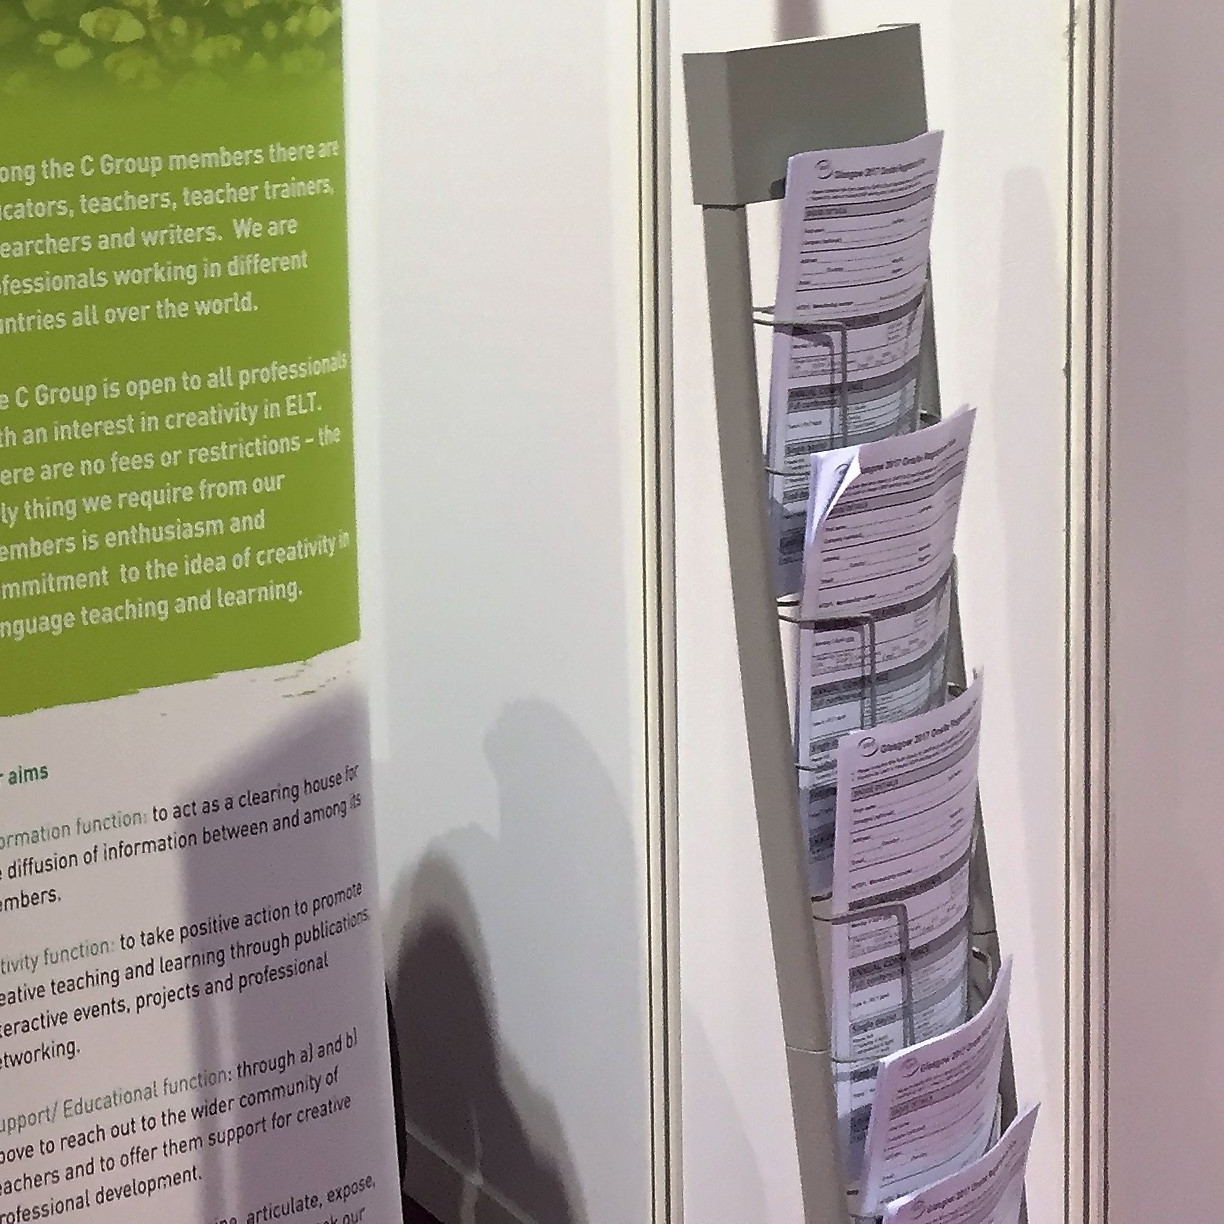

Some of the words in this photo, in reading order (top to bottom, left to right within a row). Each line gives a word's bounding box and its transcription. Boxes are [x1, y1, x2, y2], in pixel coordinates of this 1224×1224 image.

[40, 157, 75, 180] the
[80, 154, 95, 177] C
[99, 153, 164, 178] Group
[168, 145, 265, 171] members
[268, 141, 315, 163] there
[317, 140, 339, 158] are
[97, 226, 136, 250] and
[140, 223, 223, 248] writers.
[232, 217, 263, 240] We
[267, 217, 298, 237] are
[111, 260, 198, 286] working
[203, 258, 222, 279] in
[226, 249, 308, 277] different
[22, 426, 48, 446] an
[53, 413, 135, 442] interest
[139, 410, 160, 433] in
[164, 401, 259, 431] creativity
[263, 398, 281, 419] in
[285, 391, 322, 417] ELT.
[80, 597, 169, 626] teaching
[174, 588, 212, 614] and
[216, 579, 303, 608] learning.
[7, 764, 49, 786] aims
[43, 939, 115, 966] function:
[119, 933, 136, 951] to
[139, 925, 175, 948] take
[179, 913, 240, 945] positive
[243, 904, 291, 927] action
[294, 899, 309, 917] to
[312, 880, 363, 917] promote
[246, 1192, 323, 1224] articulate,
[326, 1174, 376, 1204] expose,
